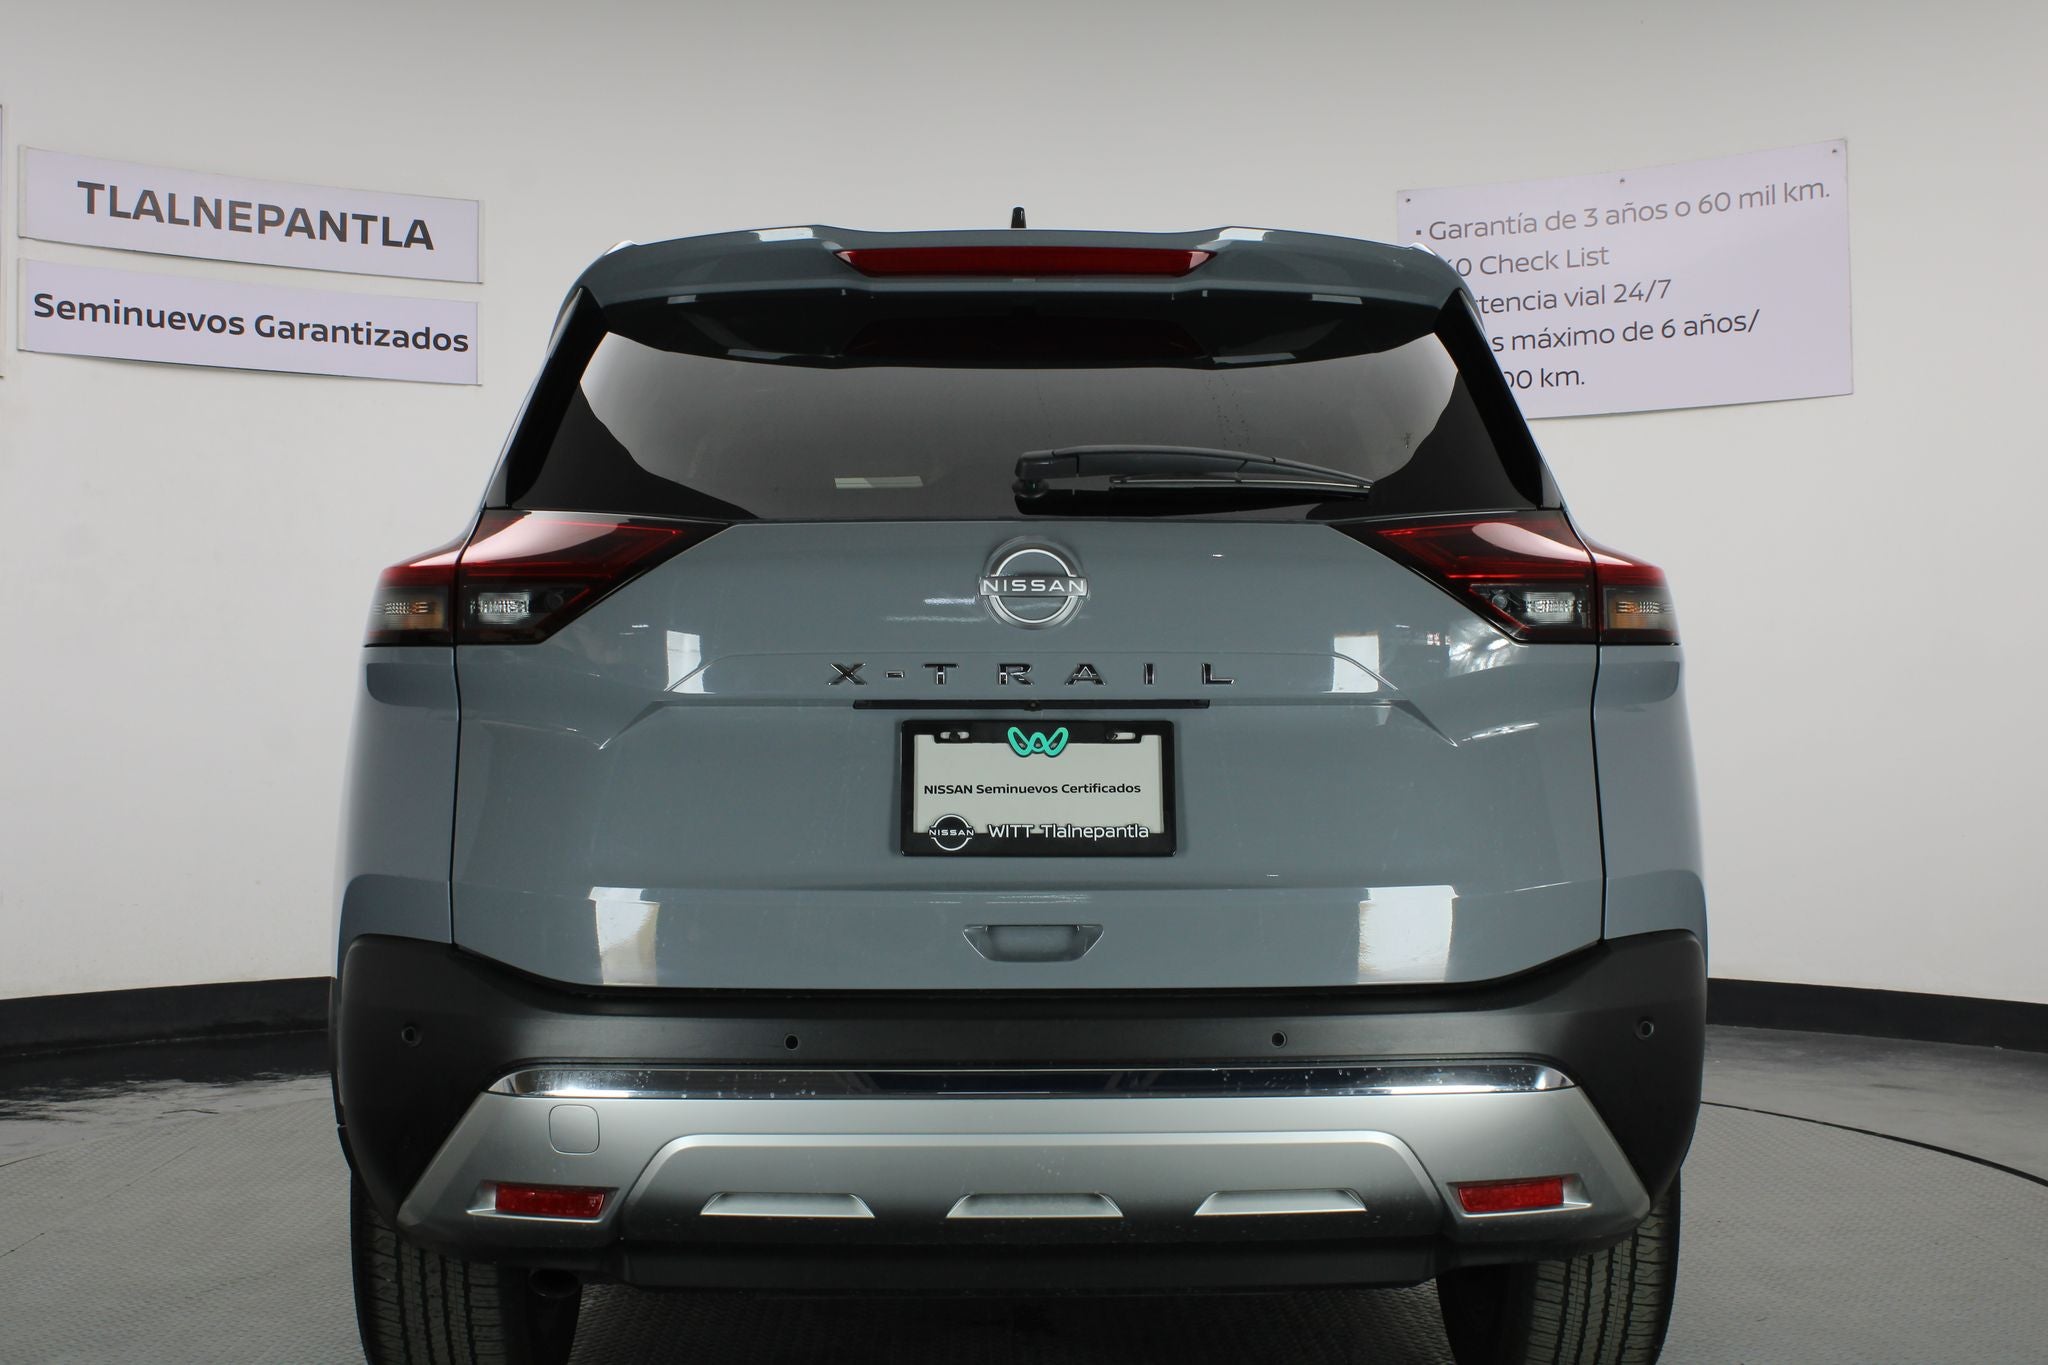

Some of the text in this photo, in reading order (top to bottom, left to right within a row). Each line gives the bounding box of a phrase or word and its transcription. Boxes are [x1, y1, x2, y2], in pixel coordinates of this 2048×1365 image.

[77, 180, 434, 251] TLALNEPANTLA
[1429, 179, 1830, 240] Garantía de 3 años o 60 mil km.
[1480, 251, 1559, 275] Check
[1566, 246, 1610, 269] List
[1476, 278, 1672, 314] tencia vial 24/7
[34, 293, 469, 353] Seminuevos Garantizados
[1511, 327, 1615, 350] máximo
[1622, 321, 1654, 342] de
[1661, 318, 1676, 339] 6
[1684, 308, 1760, 336] años/
[1540, 367, 1585, 387] km.
[983, 579, 1084, 592] NISSAN
[829, 663, 1234, 686] X-TRAIL
[924, 782, 1141, 795] NISSAN Seminuevos Certificados
[928, 828, 975, 837] NISSAN
[988, 824, 1149, 841] WITT Tlalnepantla
